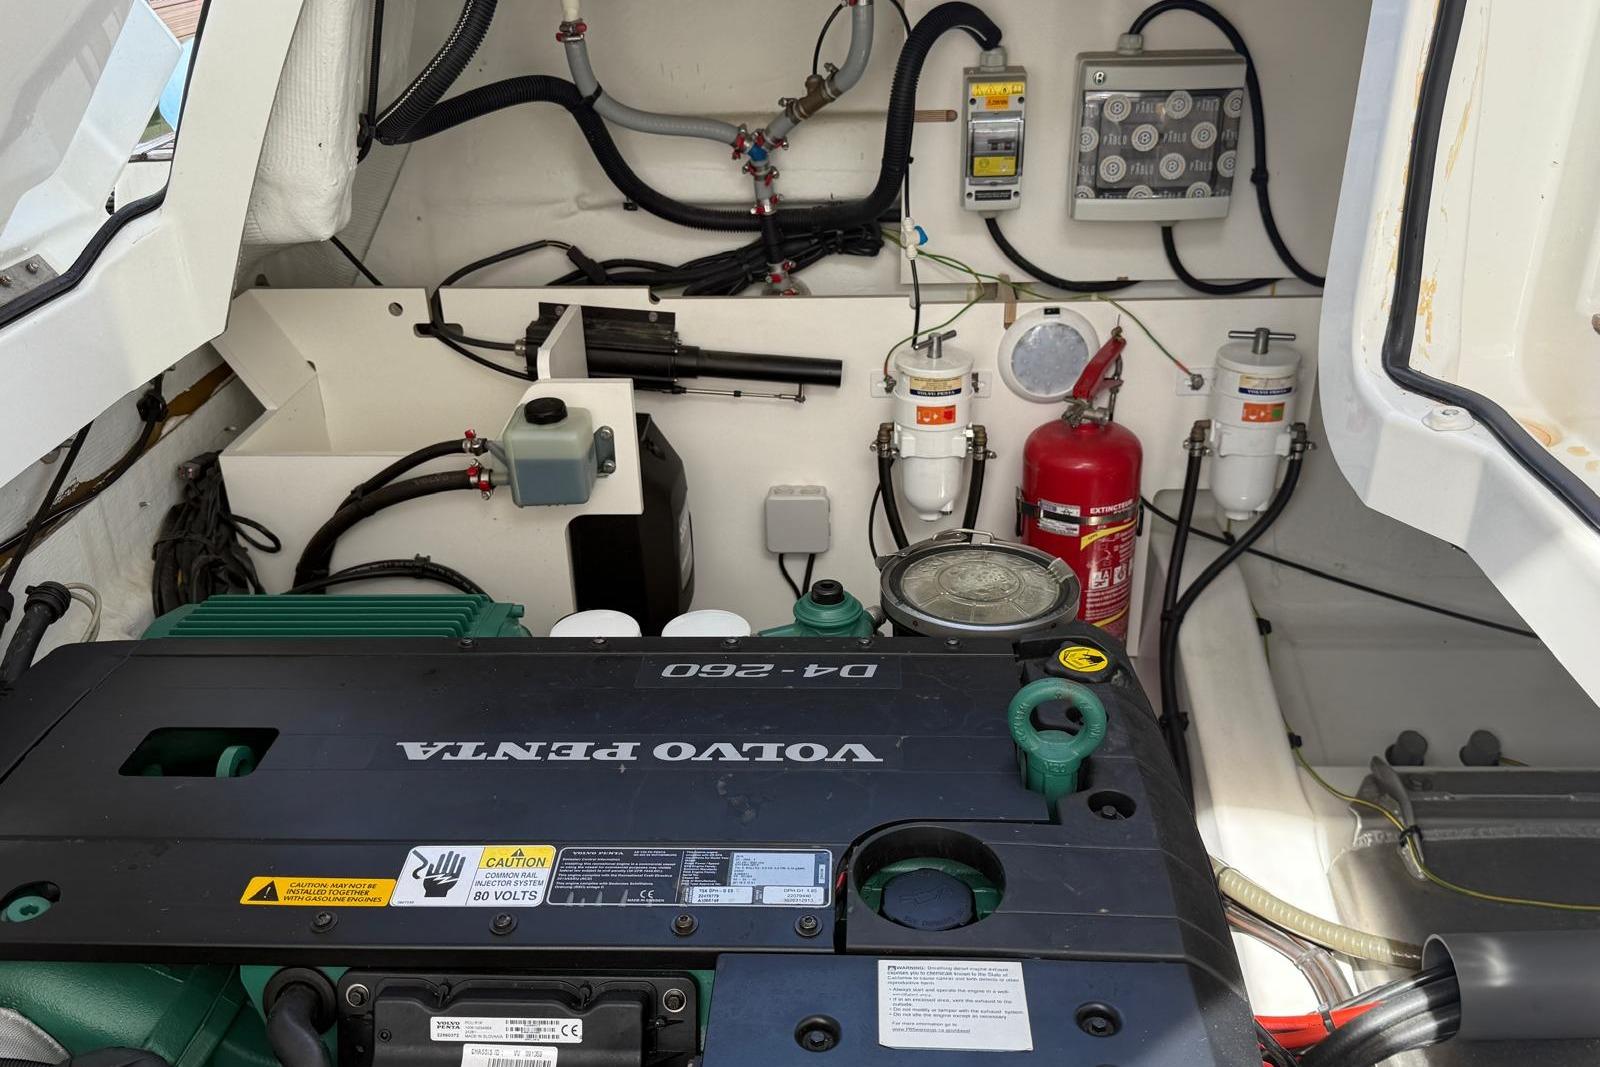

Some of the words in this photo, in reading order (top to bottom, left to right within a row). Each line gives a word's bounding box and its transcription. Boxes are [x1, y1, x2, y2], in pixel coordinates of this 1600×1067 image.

[396, 742, 641, 761] PENTA
[653, 742, 884, 762] VOLVO
[486, 857, 547, 868] CAUTION
[473, 891, 490, 901] 80
[494, 890, 538, 901] VOLTS
